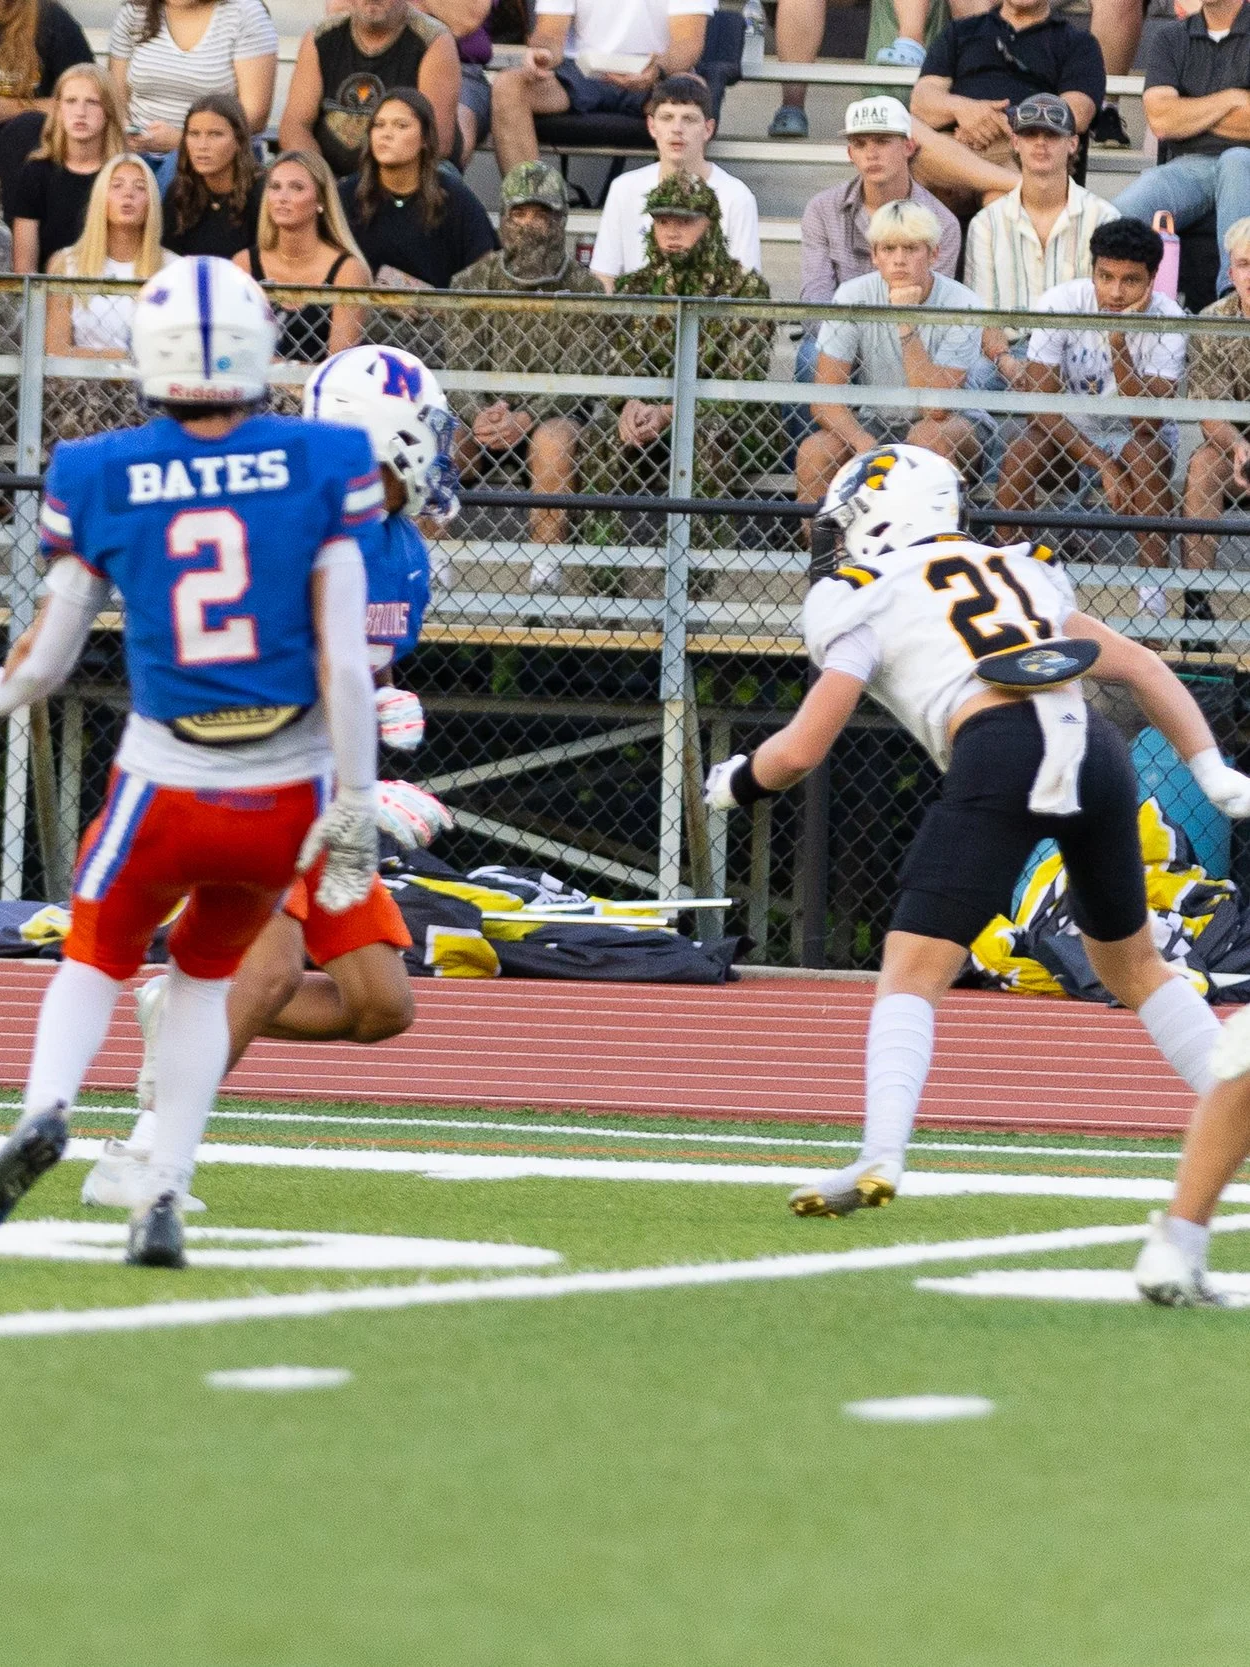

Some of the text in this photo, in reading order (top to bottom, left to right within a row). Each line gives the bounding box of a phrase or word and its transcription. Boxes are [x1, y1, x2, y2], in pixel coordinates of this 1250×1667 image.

[854, 106, 889, 119] ABAC
[378, 351, 423, 403] N
[126, 449, 290, 505] BATES
[166, 505, 260, 668] 2
[923, 554, 1054, 660] 21
